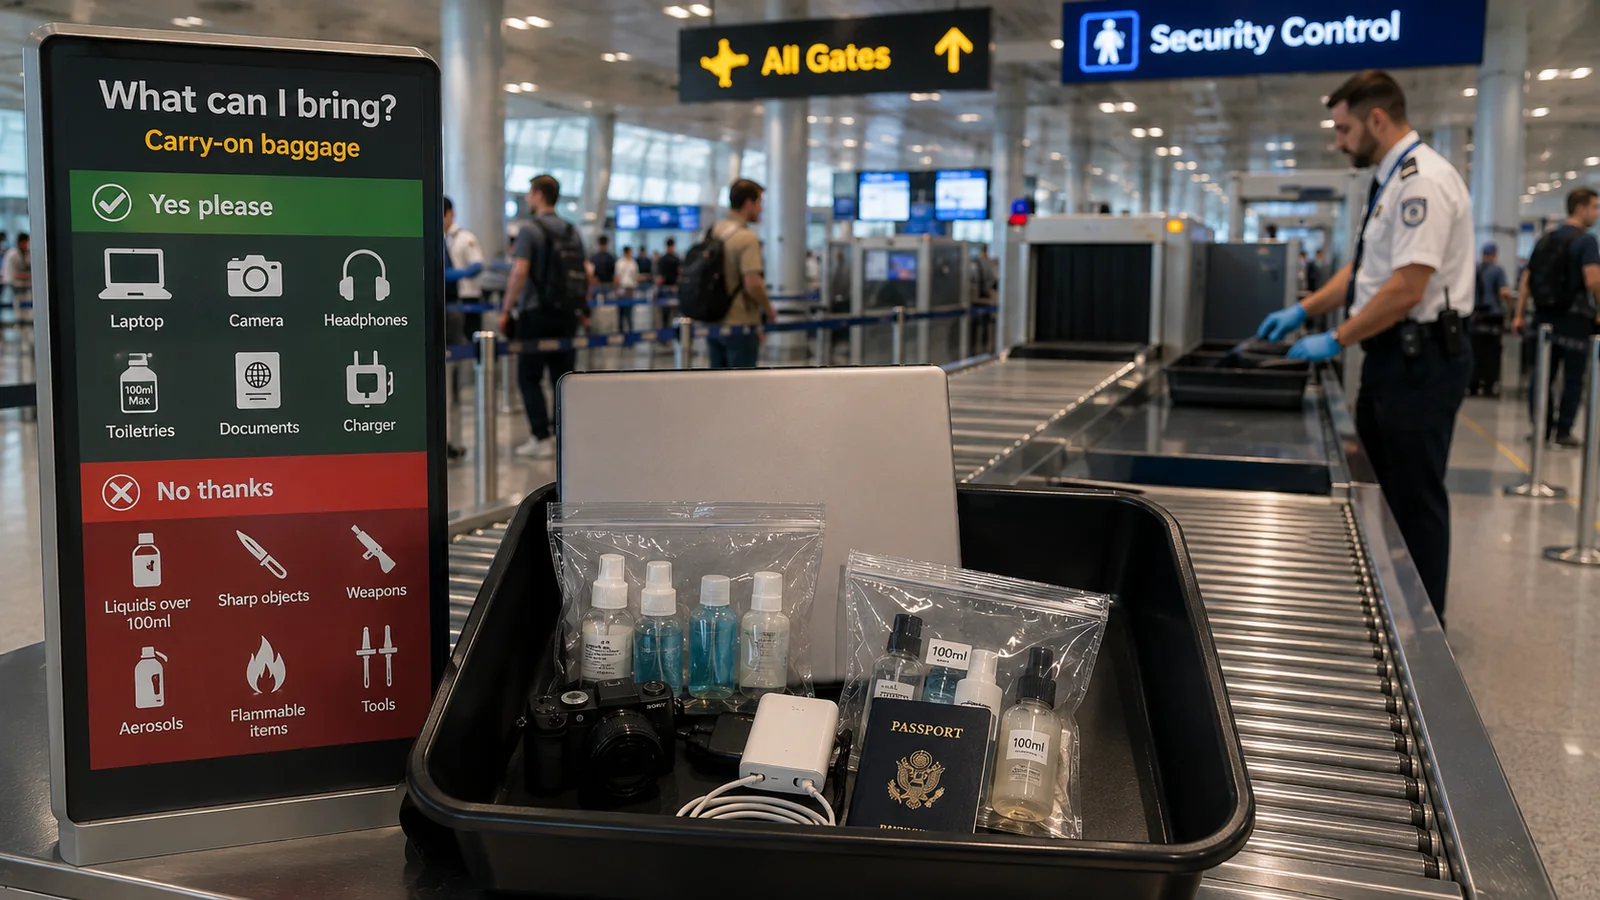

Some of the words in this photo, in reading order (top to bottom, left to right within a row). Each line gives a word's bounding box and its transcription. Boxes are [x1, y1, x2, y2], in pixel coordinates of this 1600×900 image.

[1149, 18, 1276, 56] Security
[1281, 9, 1401, 47] Control
[760, 44, 800, 77] All
[805, 43, 892, 74] Gates
[98, 79, 197, 114] What
[207, 92, 267, 116] can
[278, 88, 286, 117] I
[297, 88, 397, 128] bring?
[144, 129, 254, 158] Carry-on
[261, 132, 361, 162] baggage
[148, 193, 190, 215] Yes
[198, 193, 273, 220] please
[110, 314, 164, 331] Laptop
[229, 313, 284, 328] Camera
[324, 312, 408, 330] Headphones
[125, 385, 153, 395] 100ml
[128, 396, 151, 406] Max
[106, 423, 176, 439] Toiletries
[219, 421, 300, 436] Documents
[343, 418, 397, 434] Charger
[157, 481, 191, 501] No
[197, 477, 274, 500] thanks
[218, 592, 258, 608] Sharp
[261, 590, 310, 607] objects
[346, 585, 407, 601] Weapons
[104, 597, 157, 616] Liquids
[159, 598, 191, 611] over
[126, 613, 171, 630] 100ml
[932, 645, 968, 661] 100ml
[230, 703, 306, 723] Flammable
[361, 697, 396, 713] Tools
[119, 717, 184, 736] Aerosols
[249, 724, 288, 739] items
[890, 720, 964, 739] PASSPORT
[1013, 737, 1045, 752] 100ml
